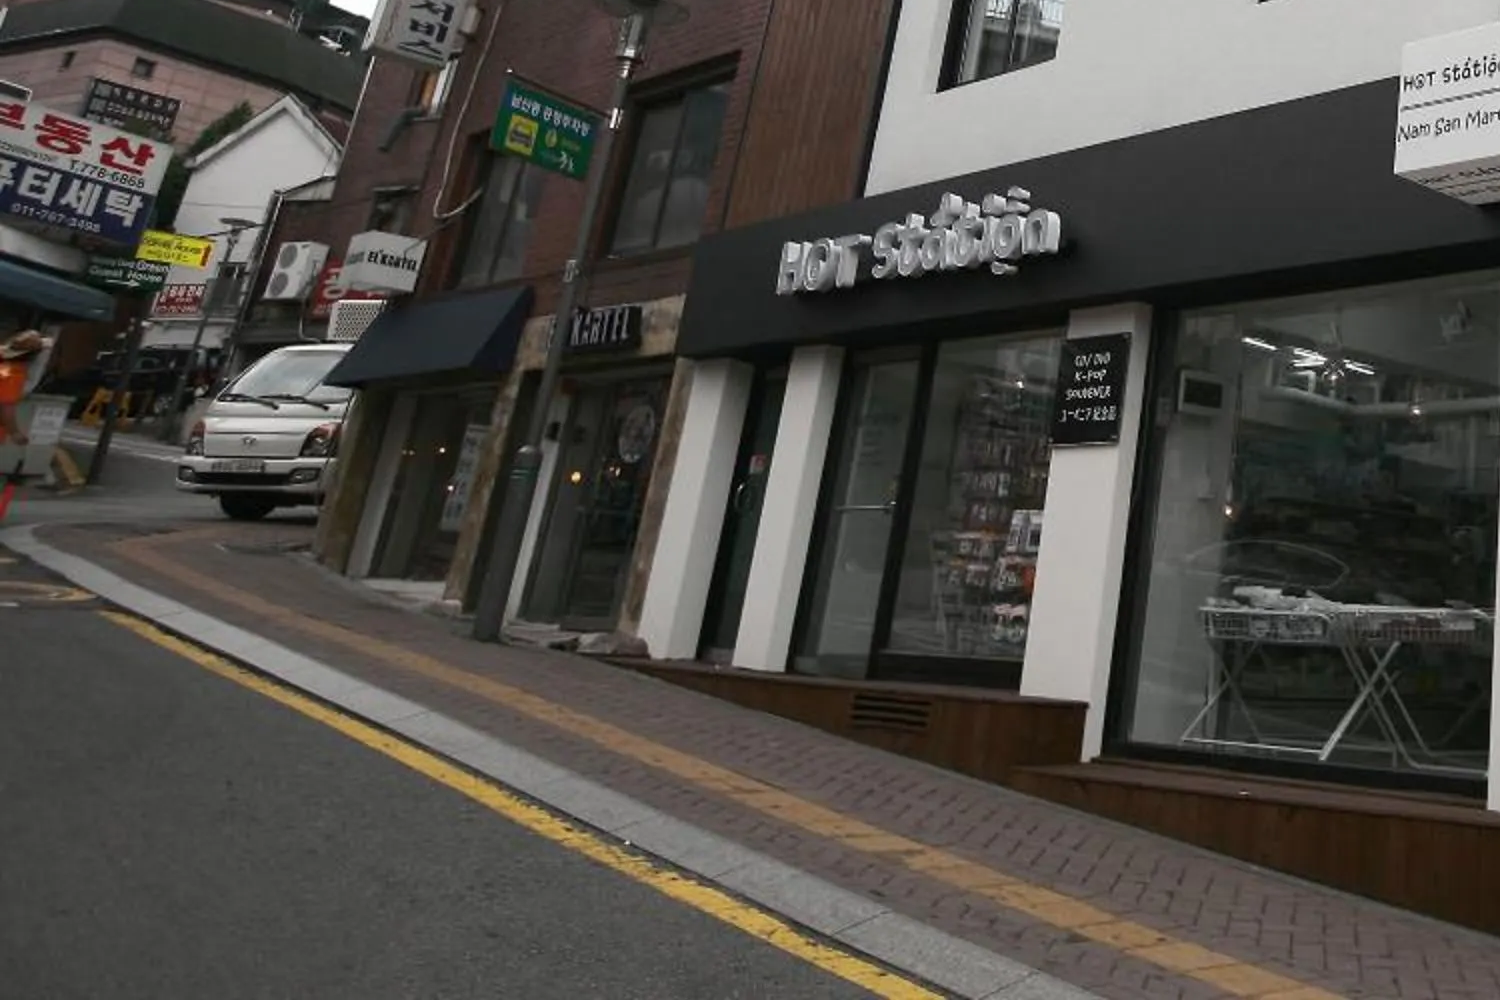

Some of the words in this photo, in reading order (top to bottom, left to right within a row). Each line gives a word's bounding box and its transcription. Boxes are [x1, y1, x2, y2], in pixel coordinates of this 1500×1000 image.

[1398, 123, 1431, 142] Nam
[1435, 116, 1461, 137] San
[776, 235, 872, 295] HOT
